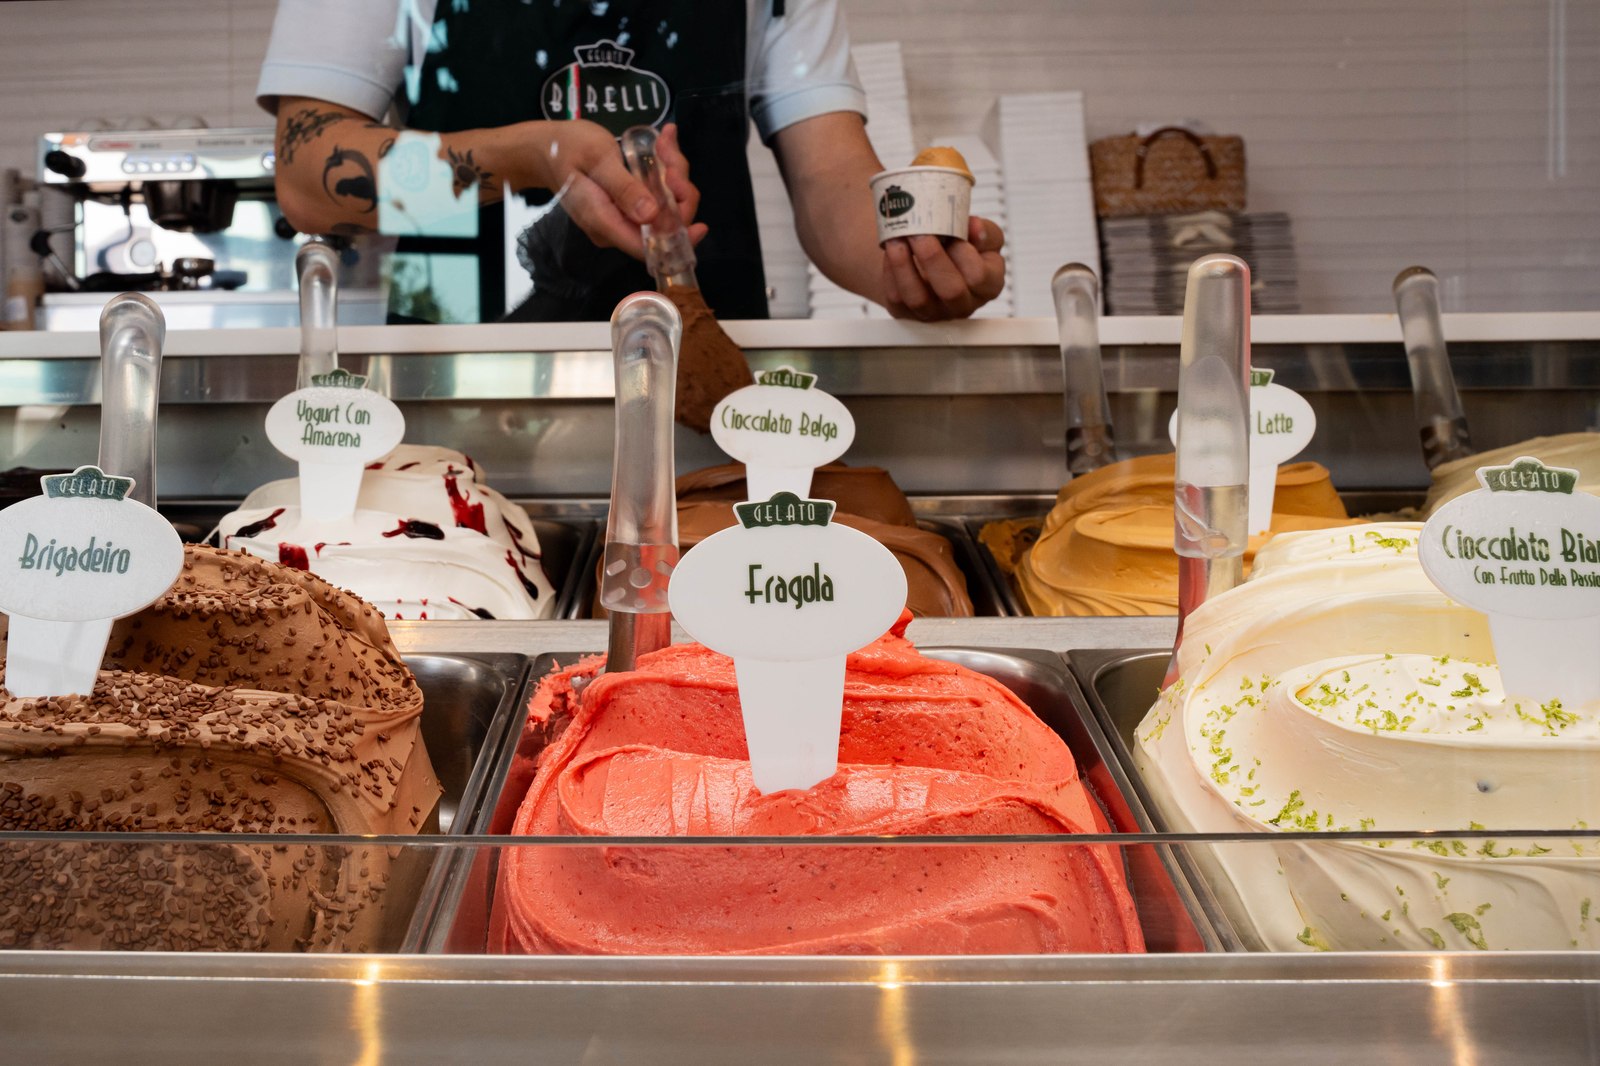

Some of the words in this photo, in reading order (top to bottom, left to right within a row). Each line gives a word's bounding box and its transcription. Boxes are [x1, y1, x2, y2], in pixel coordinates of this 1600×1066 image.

[549, 81, 660, 113] BORELLI
[763, 370, 803, 387] GELATO
[296, 400, 340, 426] Yogurt
[346, 402, 371, 425] Con
[721, 405, 792, 435] Cioccolato
[798, 411, 838, 441] Belga
[1257, 410, 1293, 435] Latte
[301, 422, 361, 448] Amarena
[60, 478, 116, 496] GELATO
[1499, 471, 1560, 489] GELATO
[753, 503, 816, 523] GELATO
[18, 532, 131, 577] Brigadeiro
[1441, 525, 1551, 563] Cioccolato
[744, 562, 834, 610] Fragola
[1474, 565, 1496, 585] Con
[1500, 566, 1536, 586] Frutto
[1539, 567, 1567, 587] Della
